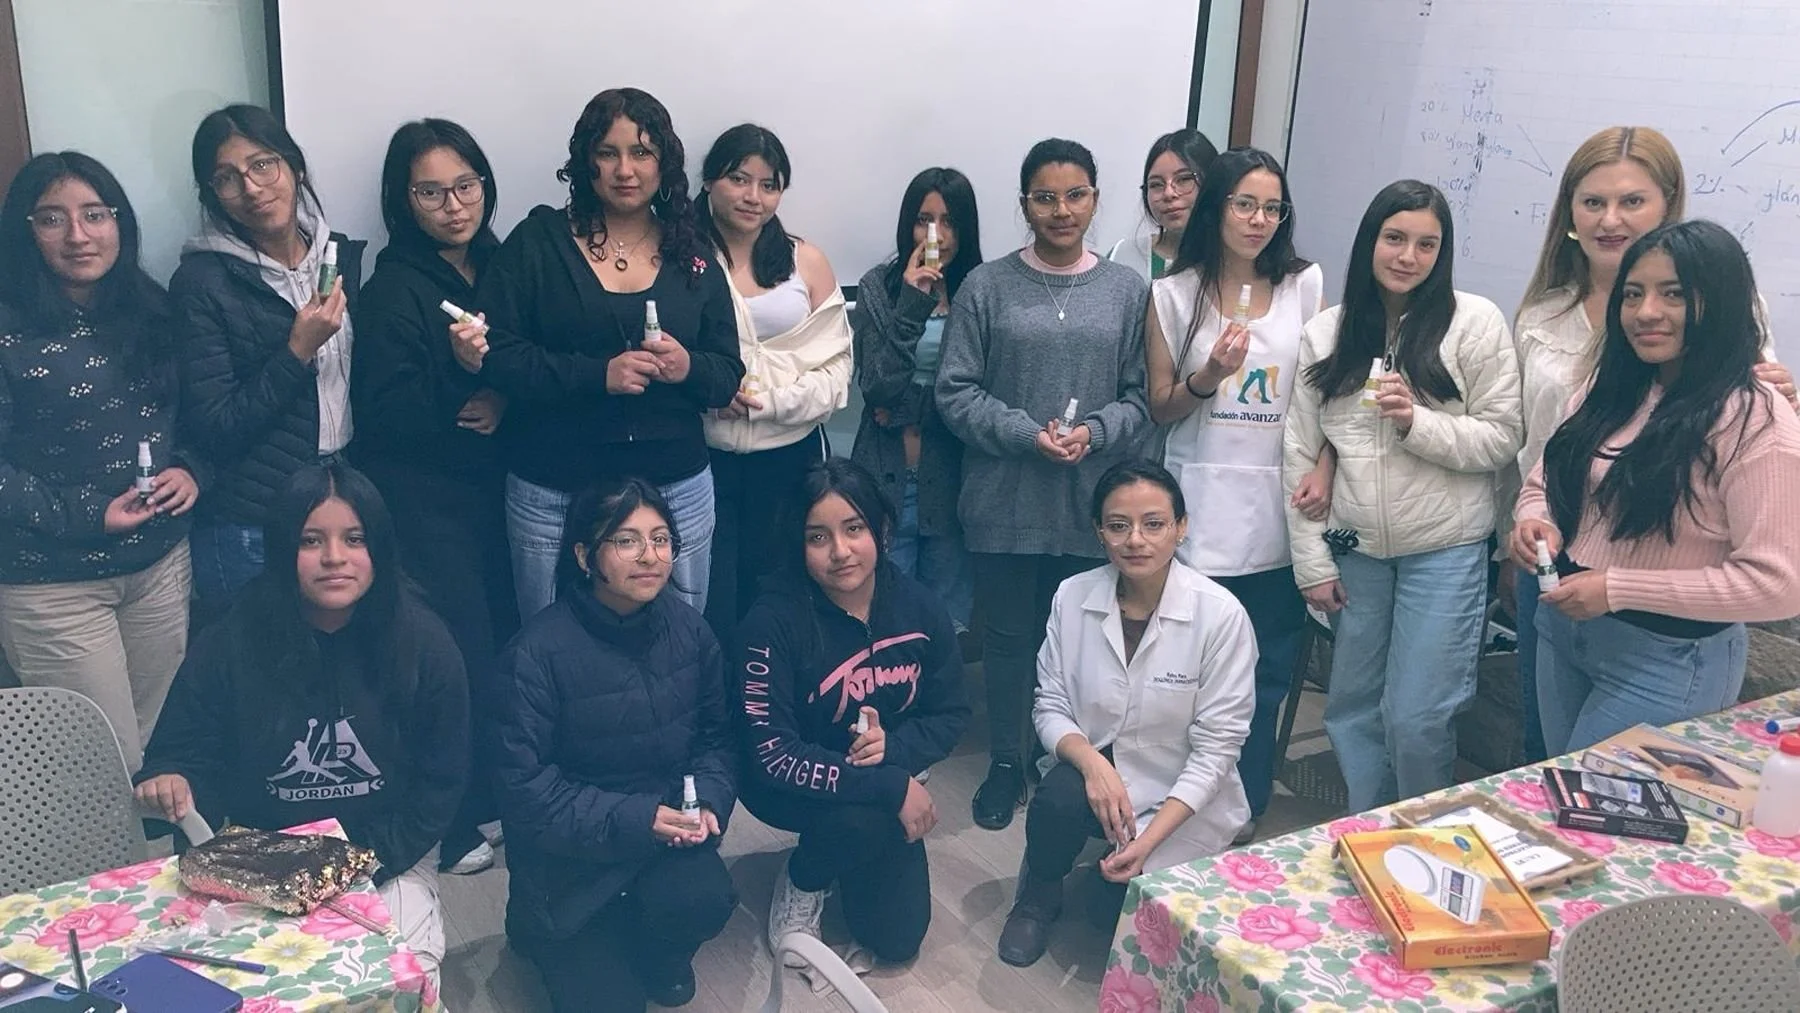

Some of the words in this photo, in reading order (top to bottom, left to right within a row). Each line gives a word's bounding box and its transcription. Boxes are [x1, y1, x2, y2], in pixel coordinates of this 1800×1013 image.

[1777, 126, 1800, 145] M
[818, 632, 930, 724] Tommy
[756, 736, 840, 793] HILFIGER
[285, 785, 355, 800] JORDAN
